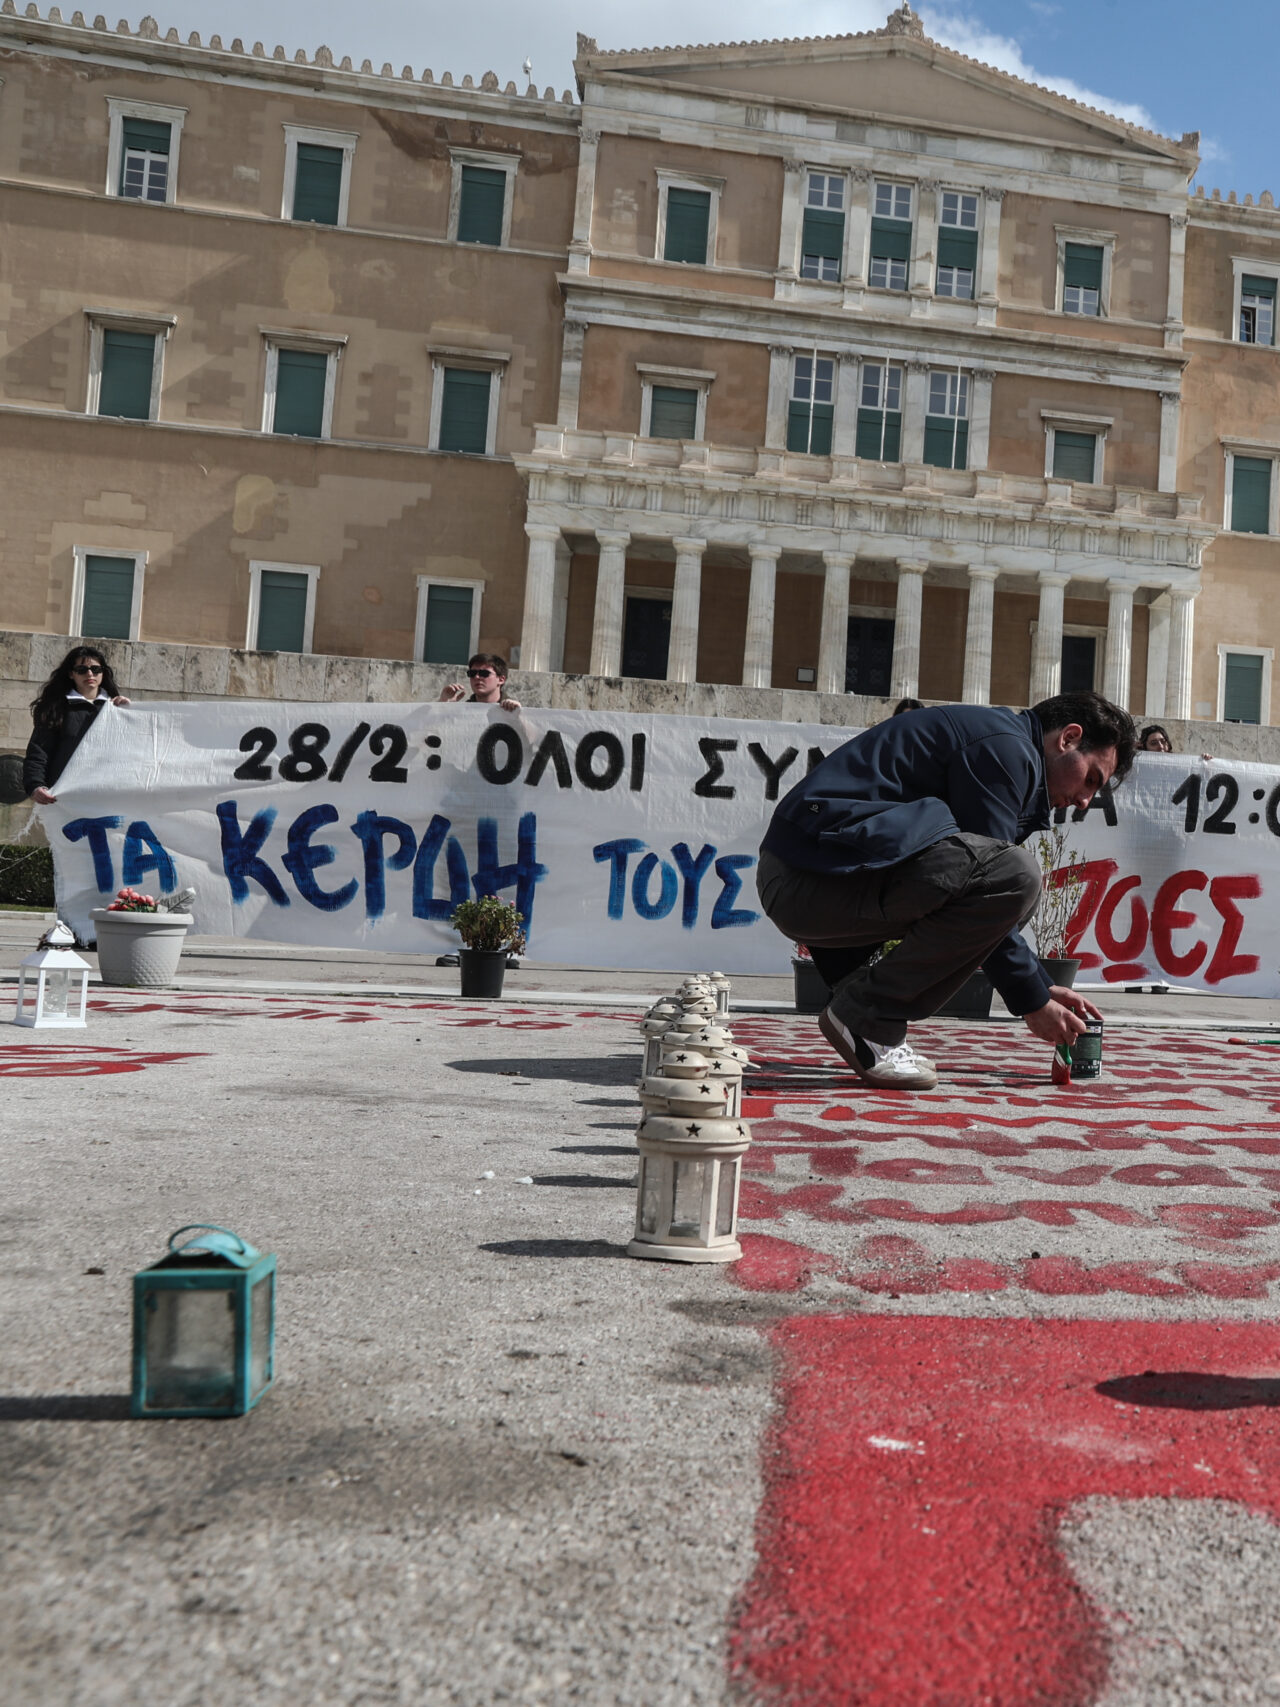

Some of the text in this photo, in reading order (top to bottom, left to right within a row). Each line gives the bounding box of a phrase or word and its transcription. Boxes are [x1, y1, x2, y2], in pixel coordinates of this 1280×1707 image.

[234, 721, 442, 783] 28/2:
[476, 722, 647, 792] ΟΛΟΙ
[62, 800, 762, 945] ΤΑ ΚΕΡΔΗ ΤΟΥΣ
